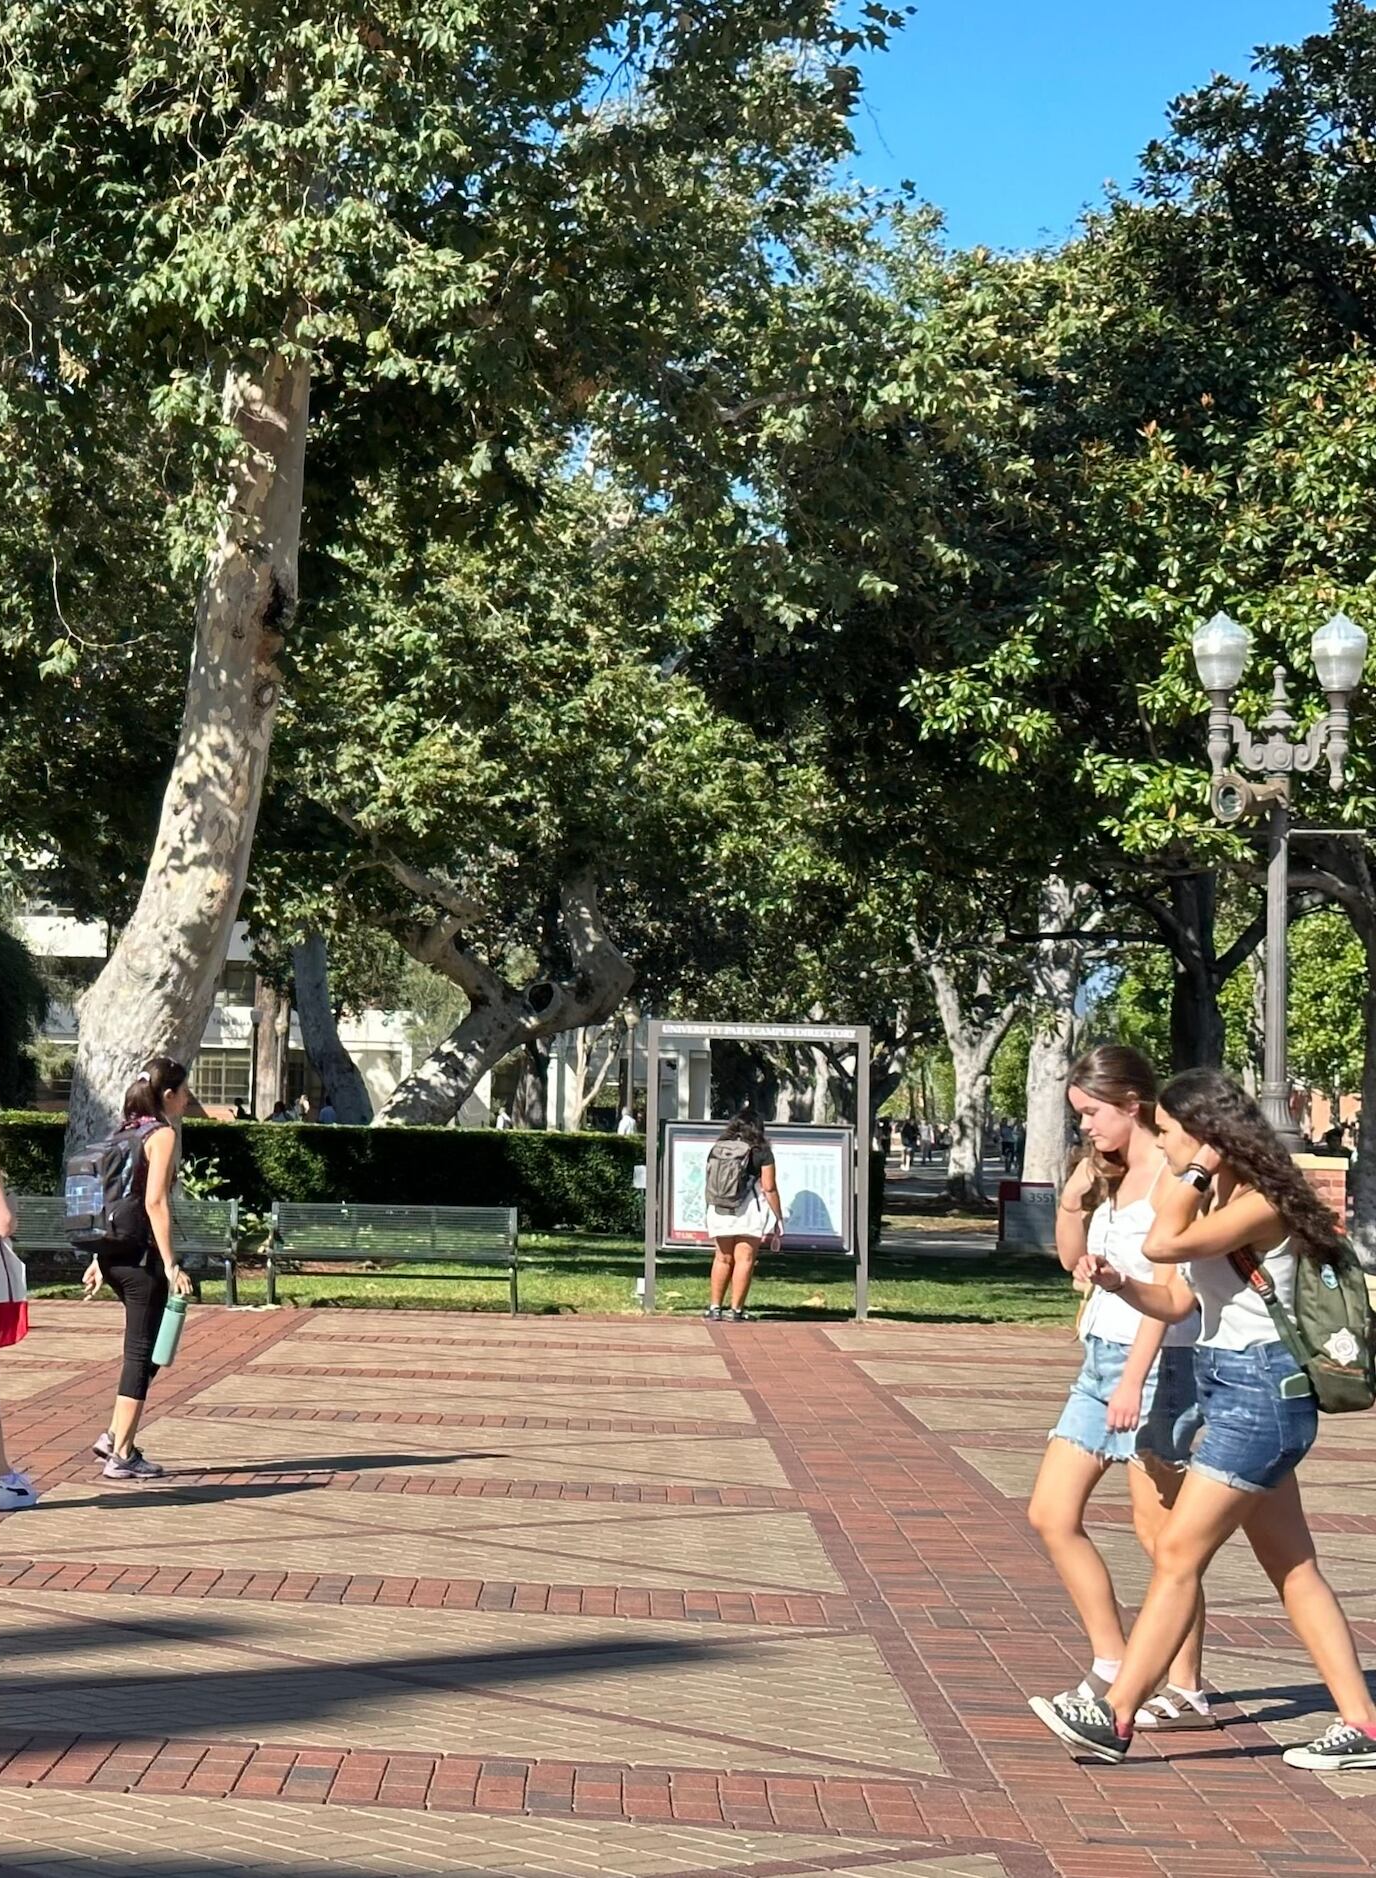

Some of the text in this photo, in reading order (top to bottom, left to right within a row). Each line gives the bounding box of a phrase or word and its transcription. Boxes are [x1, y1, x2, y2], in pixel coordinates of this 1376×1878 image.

[662, 1024, 856, 1039] UNIVERSITY PARK CAMPUS DIRECTORY
